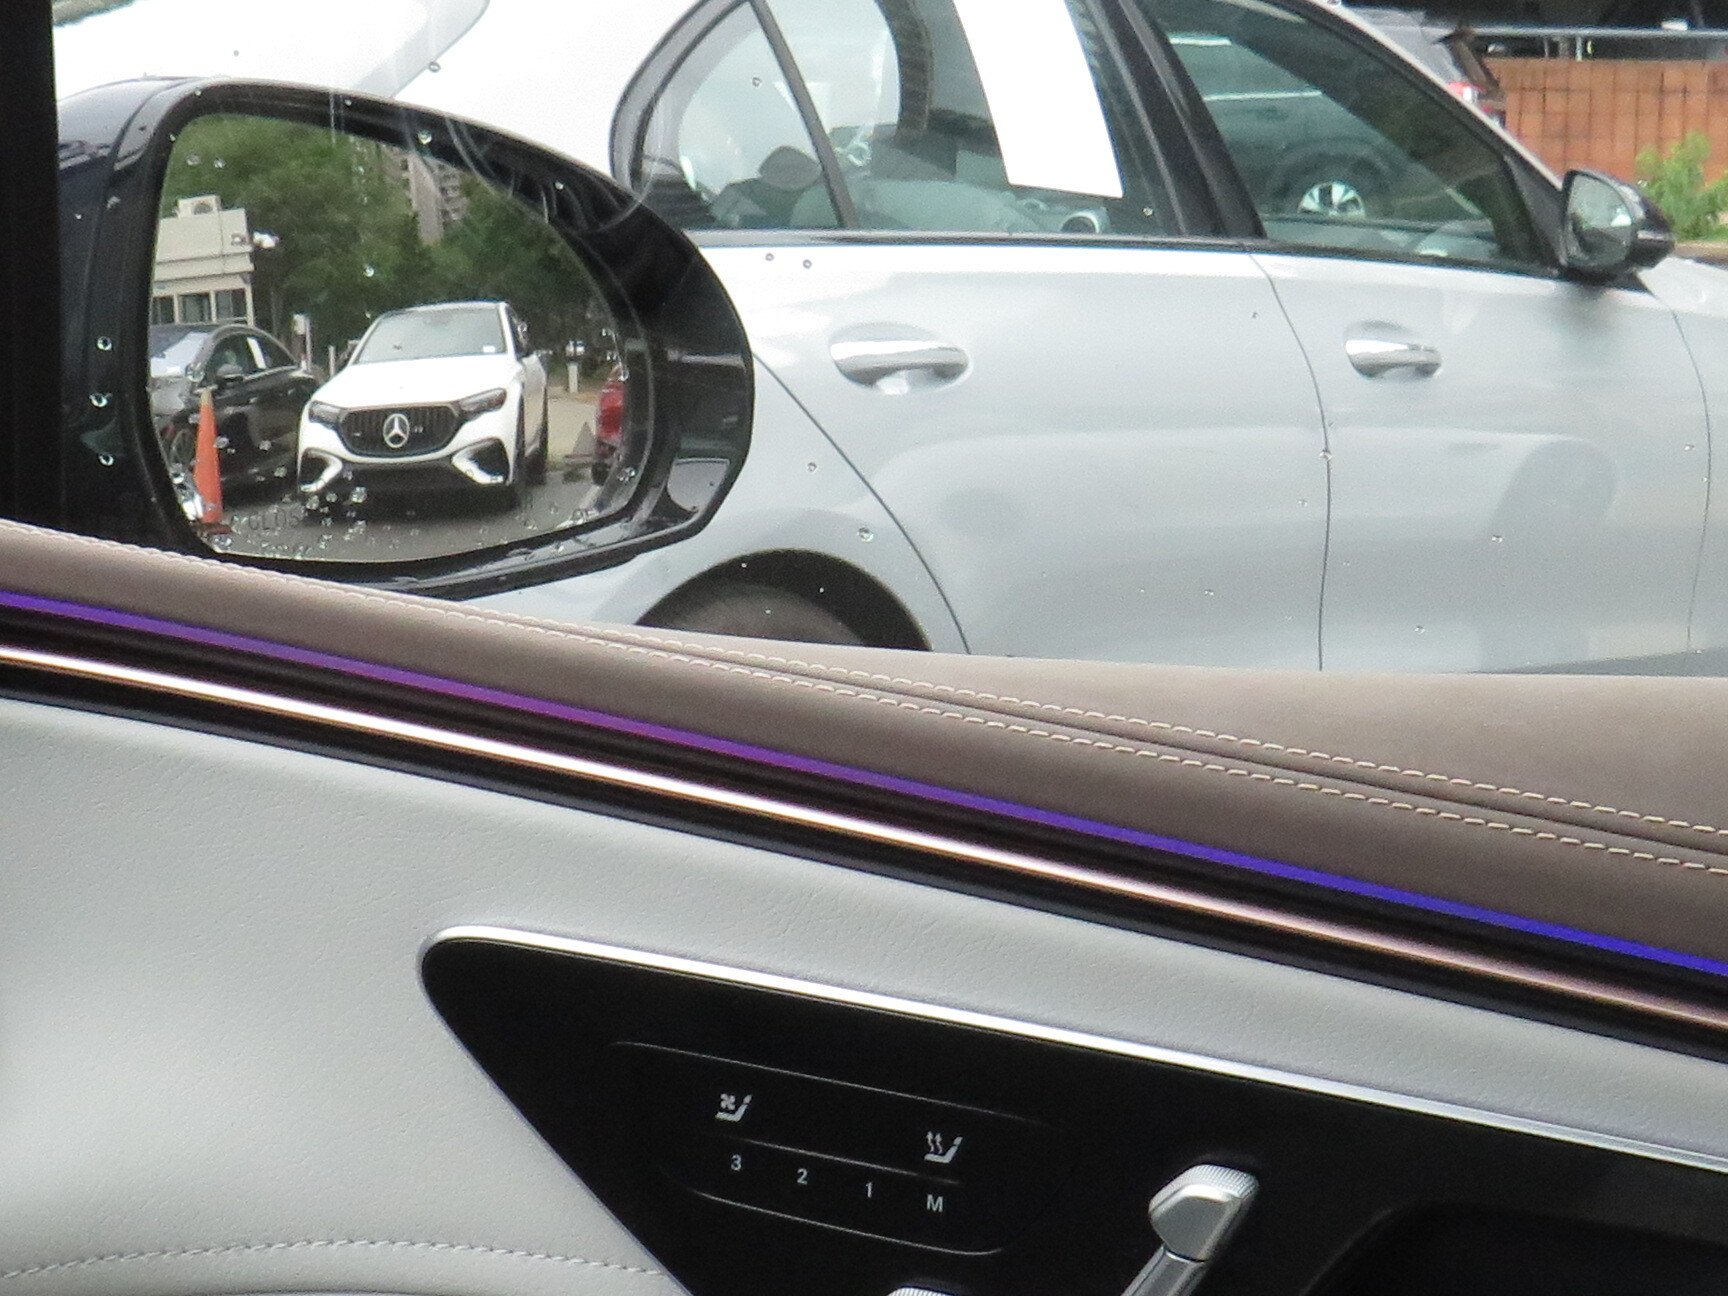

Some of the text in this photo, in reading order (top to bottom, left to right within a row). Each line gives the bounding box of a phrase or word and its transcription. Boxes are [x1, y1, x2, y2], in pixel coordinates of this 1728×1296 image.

[731, 1154, 944, 1213] 3 2 1 M
